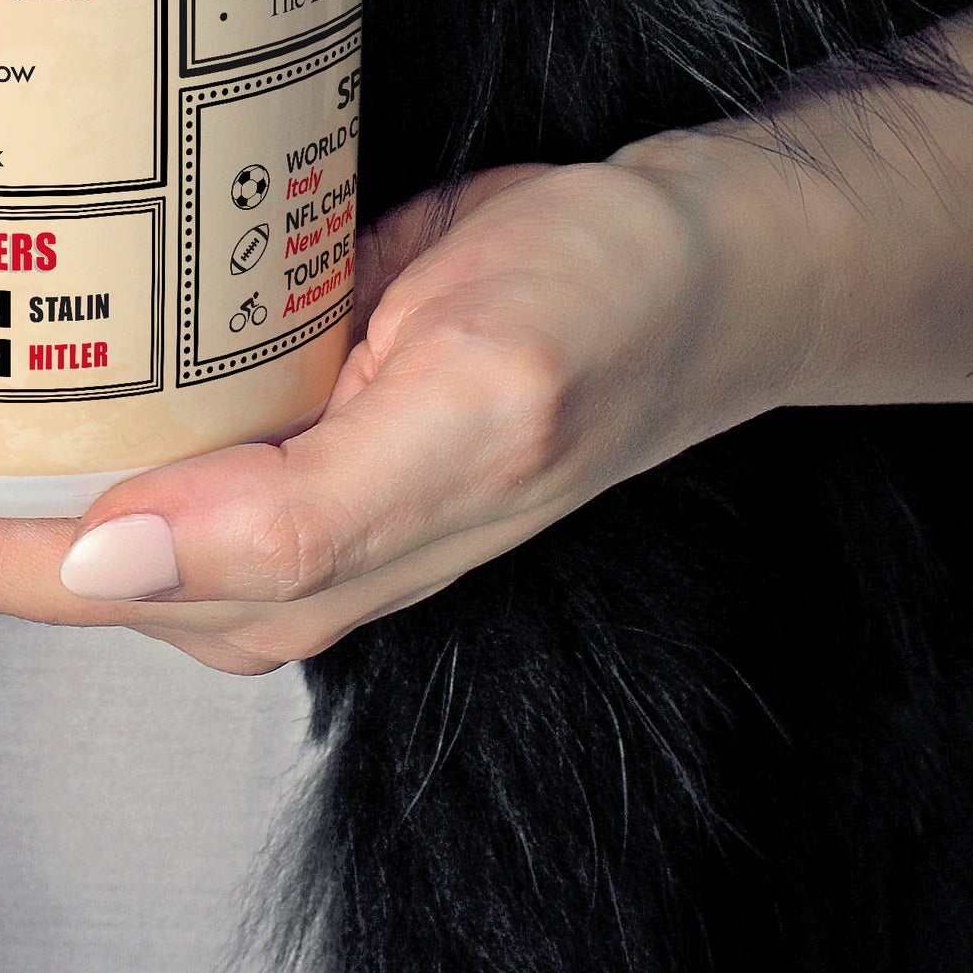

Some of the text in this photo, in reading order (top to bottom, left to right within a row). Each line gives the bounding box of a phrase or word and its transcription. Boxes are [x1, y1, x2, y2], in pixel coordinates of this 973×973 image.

[286, 126, 347, 174] WORLD
[285, 166, 324, 200] Italy
[284, 200, 319, 233] NFL
[284, 227, 323, 260] New
[325, 200, 354, 237] York
[283, 249, 330, 291] TOUR
[333, 233, 350, 265] DE
[29, 293, 111, 324] STALIN
[282, 269, 342, 318] Antonin
[29, 341, 109, 371] HITLER
